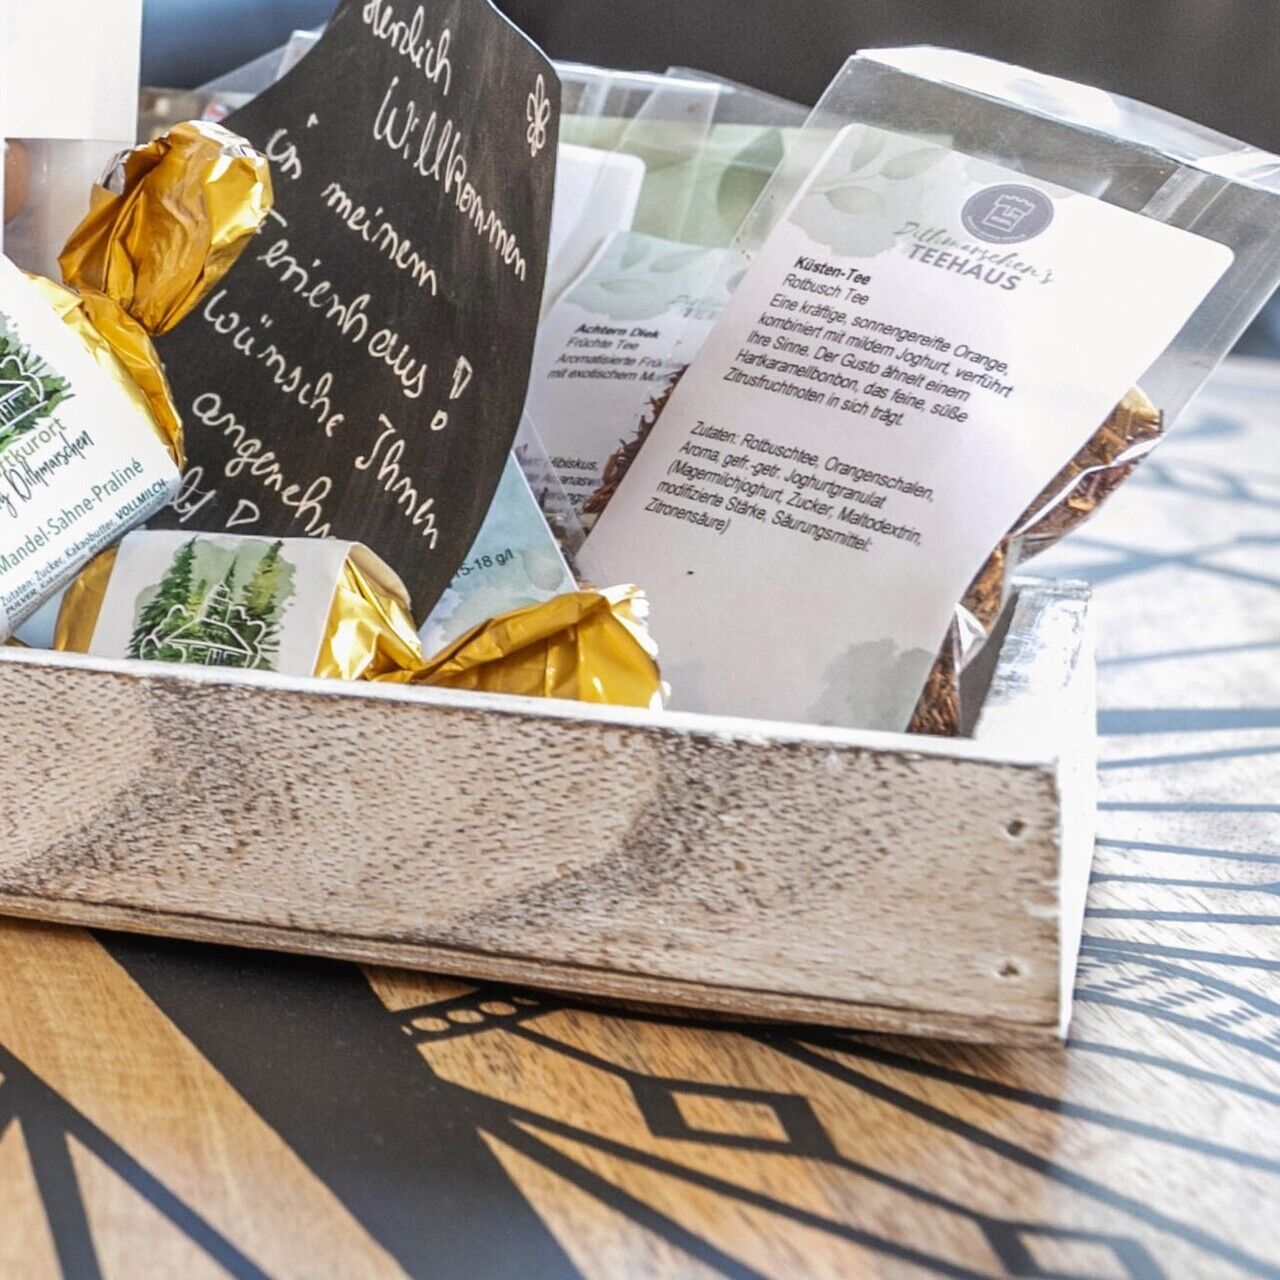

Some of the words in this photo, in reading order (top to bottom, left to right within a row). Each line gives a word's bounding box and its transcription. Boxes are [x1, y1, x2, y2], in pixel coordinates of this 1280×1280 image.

[372, 75, 526, 282] Willkommen
[320, 181, 438, 296] meinem
[793, 255, 872, 286] Küsten-Tee
[907, 243, 1022, 291] TEEHAUS
[781, 273, 842, 299] Rotbusch
[843, 284, 870, 306] Tee
[565, 336, 613, 350] Früchte
[616, 338, 640, 351] Tee
[746, 330, 772, 347] Ihre
[771, 336, 810, 357] Sinne.
[813, 345, 840, 363] Der
[840, 352, 881, 375] Gusto
[882, 362, 925, 387] ähnelt
[925, 378, 972, 403] einem
[757, 311, 822, 339] kombiniert
[822, 329, 845, 344] mit
[845, 334, 895, 357] mildem
[954, 367, 1014, 399] verführt
[769, 292, 799, 311] Eine
[850, 315, 952, 353] sonnengereifte
[952, 344, 1010, 376] Orange,
[722, 366, 825, 405] Zitrusfruchtnoten
[826, 392, 841, 408] in
[841, 397, 871, 417] sich
[870, 405, 904, 428] trägt.
[735, 348, 859, 393] Hartkaramellbonbon,
[862, 381, 889, 400] das
[890, 388, 926, 413] feine,
[929, 401, 969, 424] süße
[4, 429, 96, 504] Dithmarschen
[678, 440, 720, 465] Aroma,
[783, 470, 888, 509] Joghurtgranulat
[690, 420, 738, 444] Zutaten:
[740, 432, 820, 469] Rotbuschtee,
[823, 455, 935, 503] Orangenschalen,
[644, 497, 731, 537] Zitronensäure)
[656, 478, 725, 508] modifizierte
[725, 495, 767, 523] Stärke,
[786, 491, 834, 519] Zucker,
[836, 505, 923, 547] Maltodextrin,
